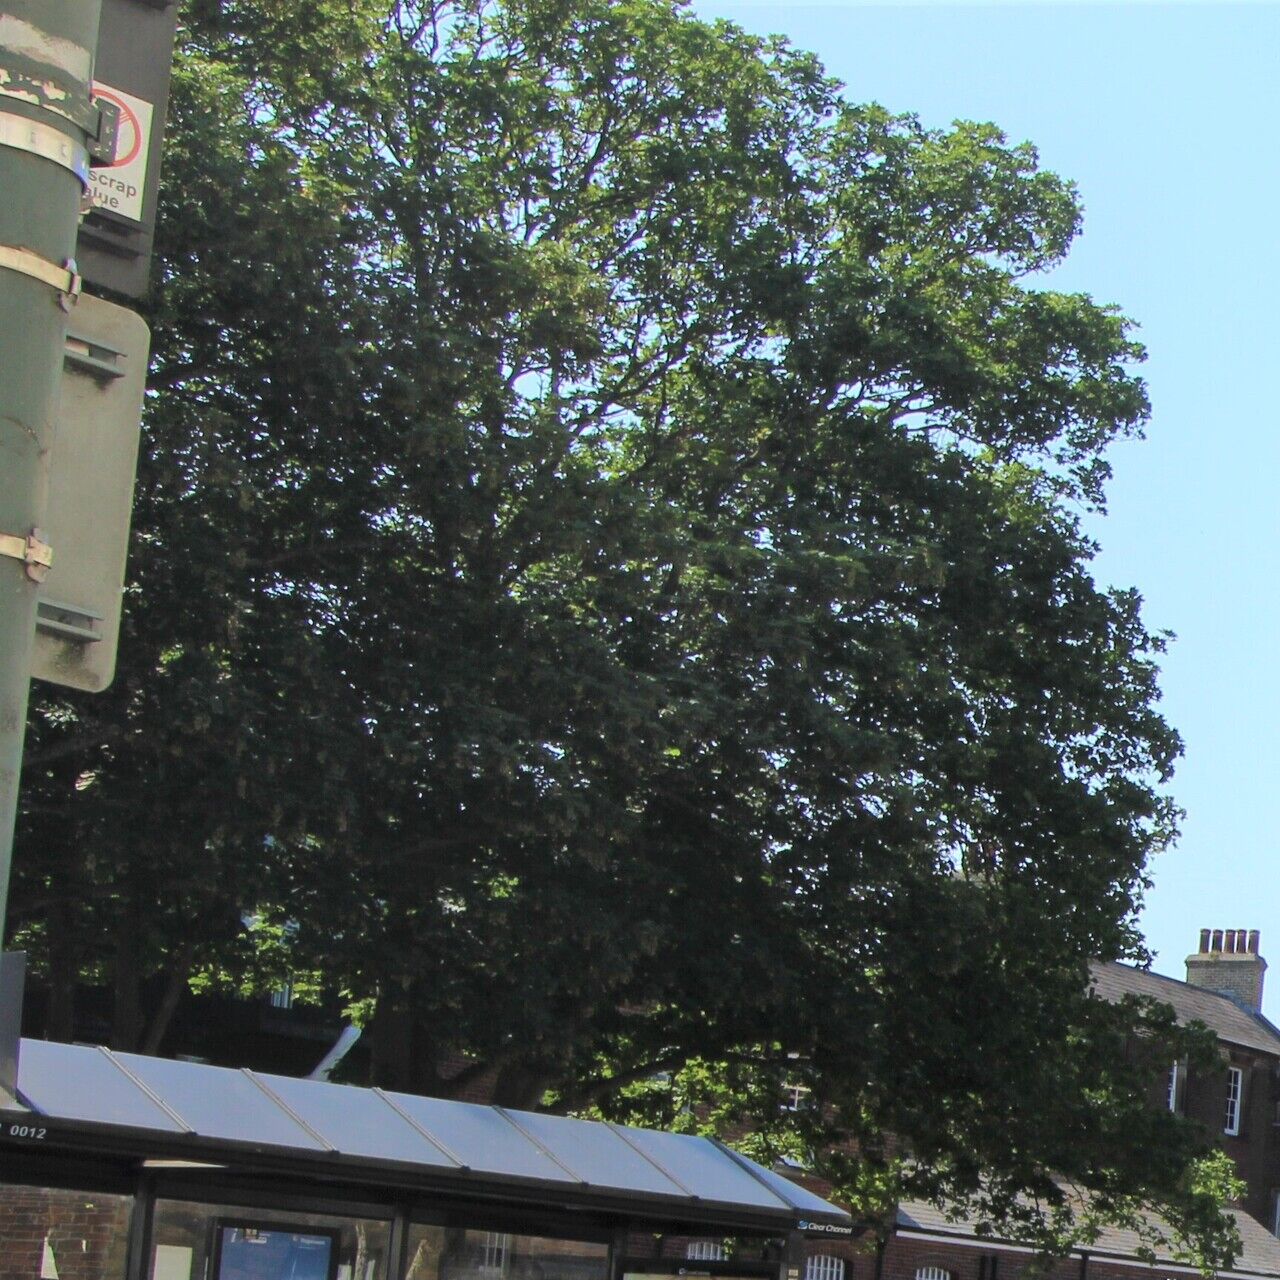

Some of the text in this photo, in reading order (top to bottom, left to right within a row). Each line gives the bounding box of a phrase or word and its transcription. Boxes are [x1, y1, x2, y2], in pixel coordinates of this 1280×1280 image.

[89, 170, 137, 198] scrap
[85, 187, 119, 208] alue
[10, 1125, 47, 1139] 0012
